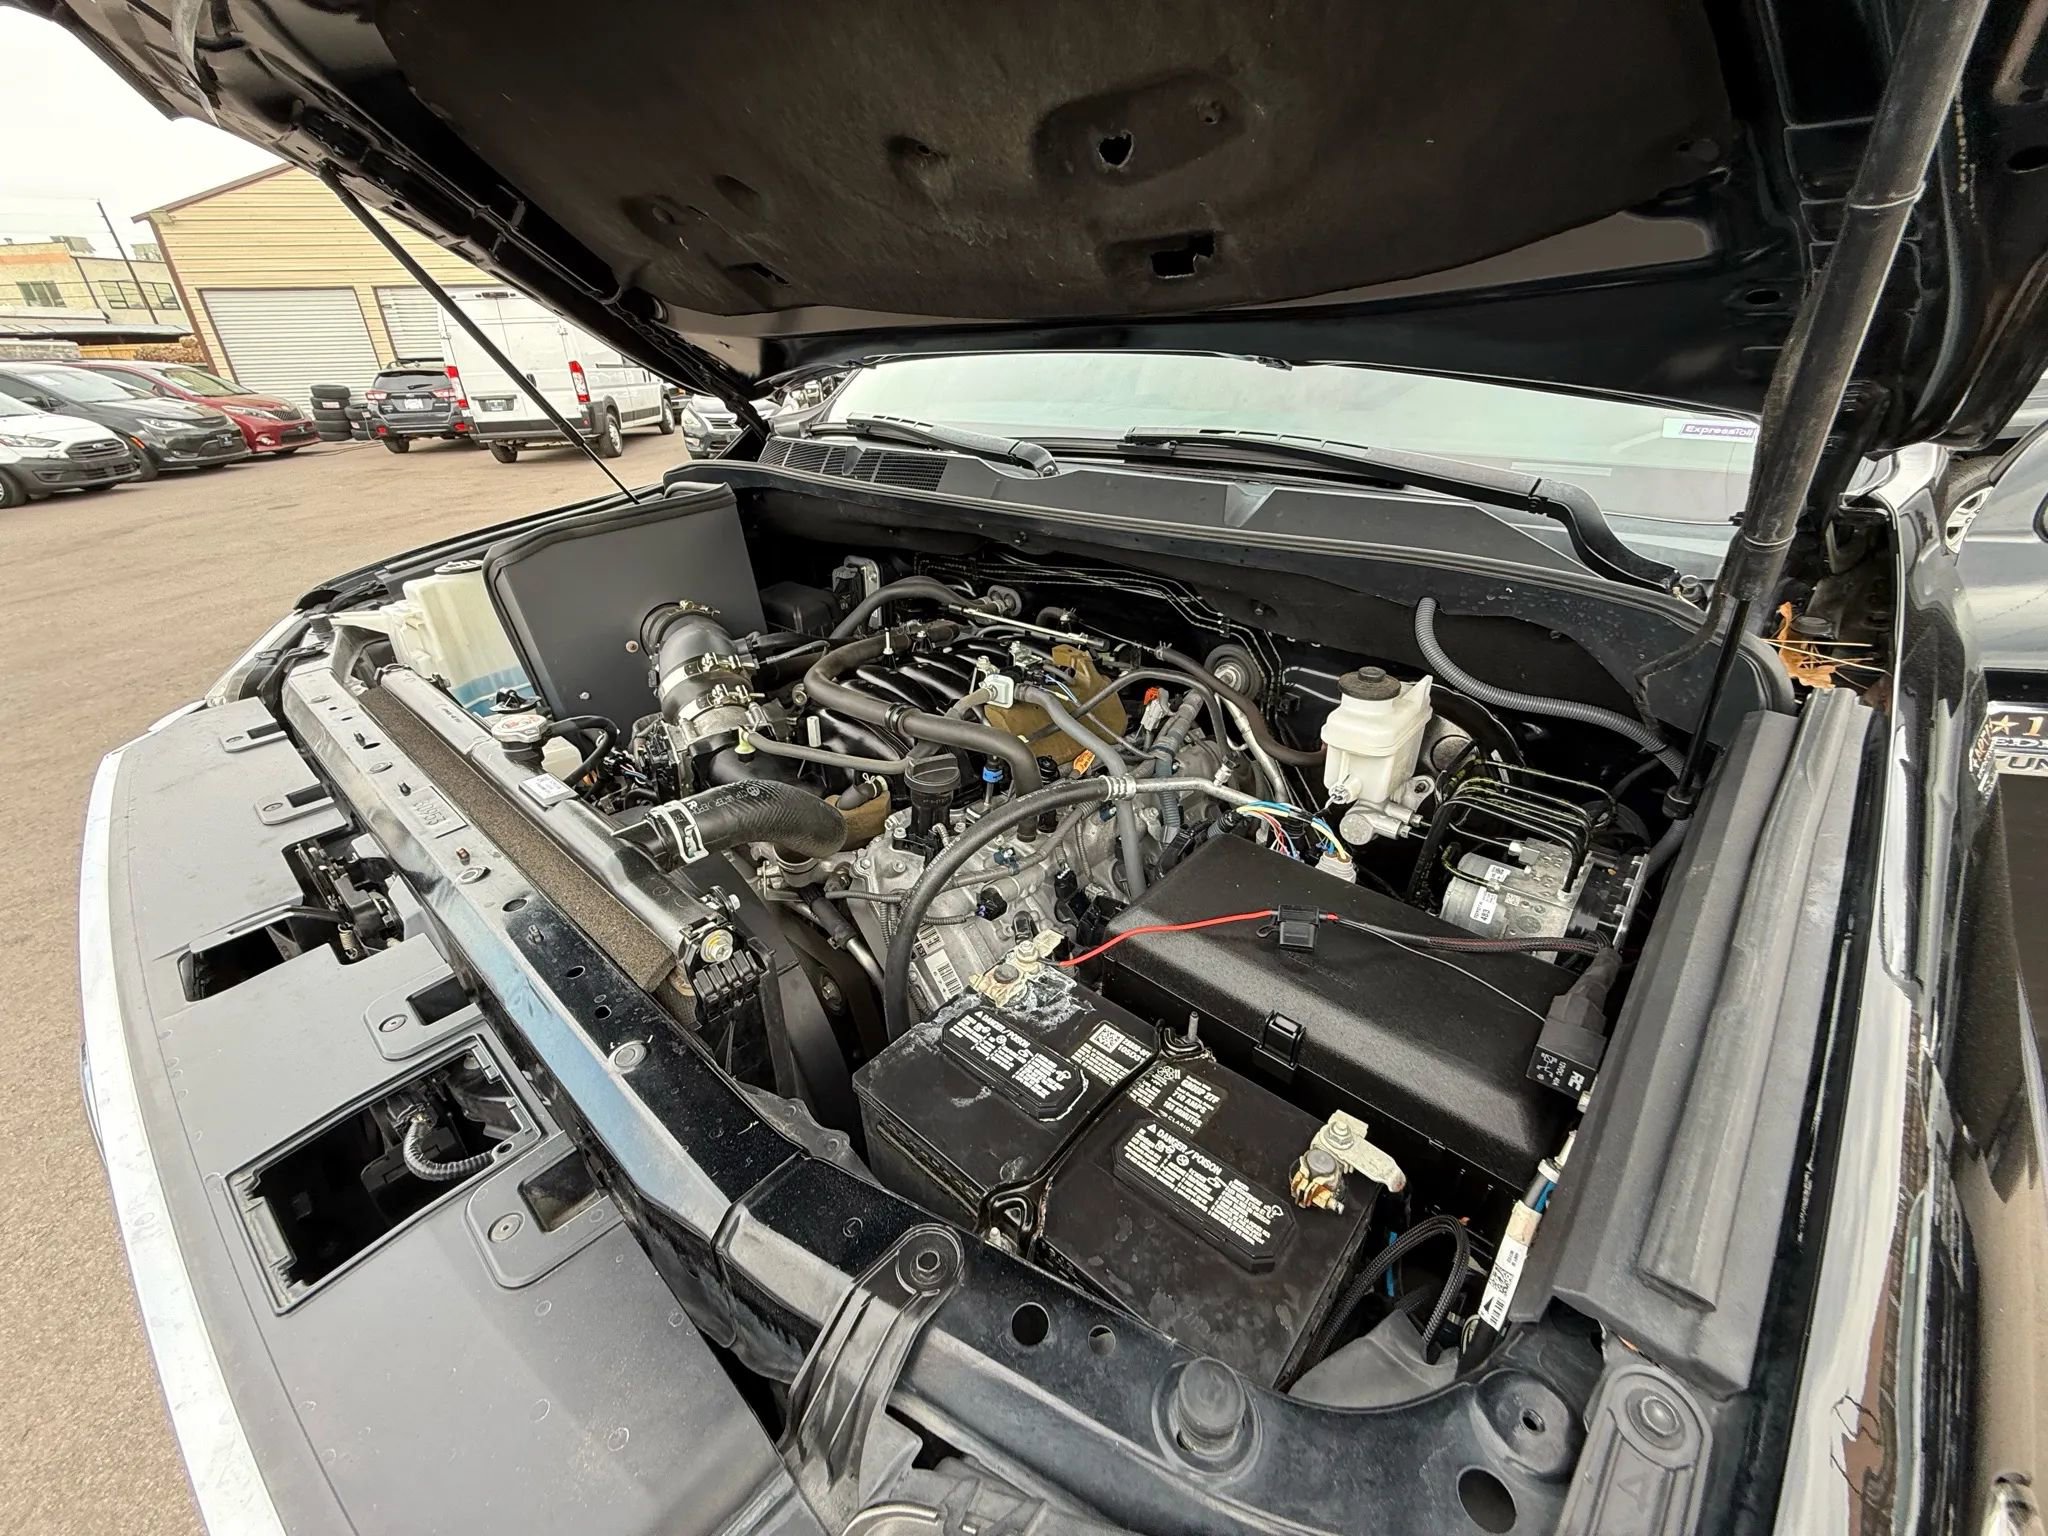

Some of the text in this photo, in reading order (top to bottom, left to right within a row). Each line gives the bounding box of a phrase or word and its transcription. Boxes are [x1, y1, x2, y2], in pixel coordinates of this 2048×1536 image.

[1685, 425, 1753, 436] ExpressToll
[1180, 1079, 1206, 1095] GROUP
[1203, 1092, 1221, 1104] 27F
[1184, 1098, 1207, 1114] AMPS
[1167, 1115, 1195, 1135] CLARIOS
[1173, 1107, 1203, 1128] MINUTES
[1156, 1128, 1223, 1176] DANGER/POISON
